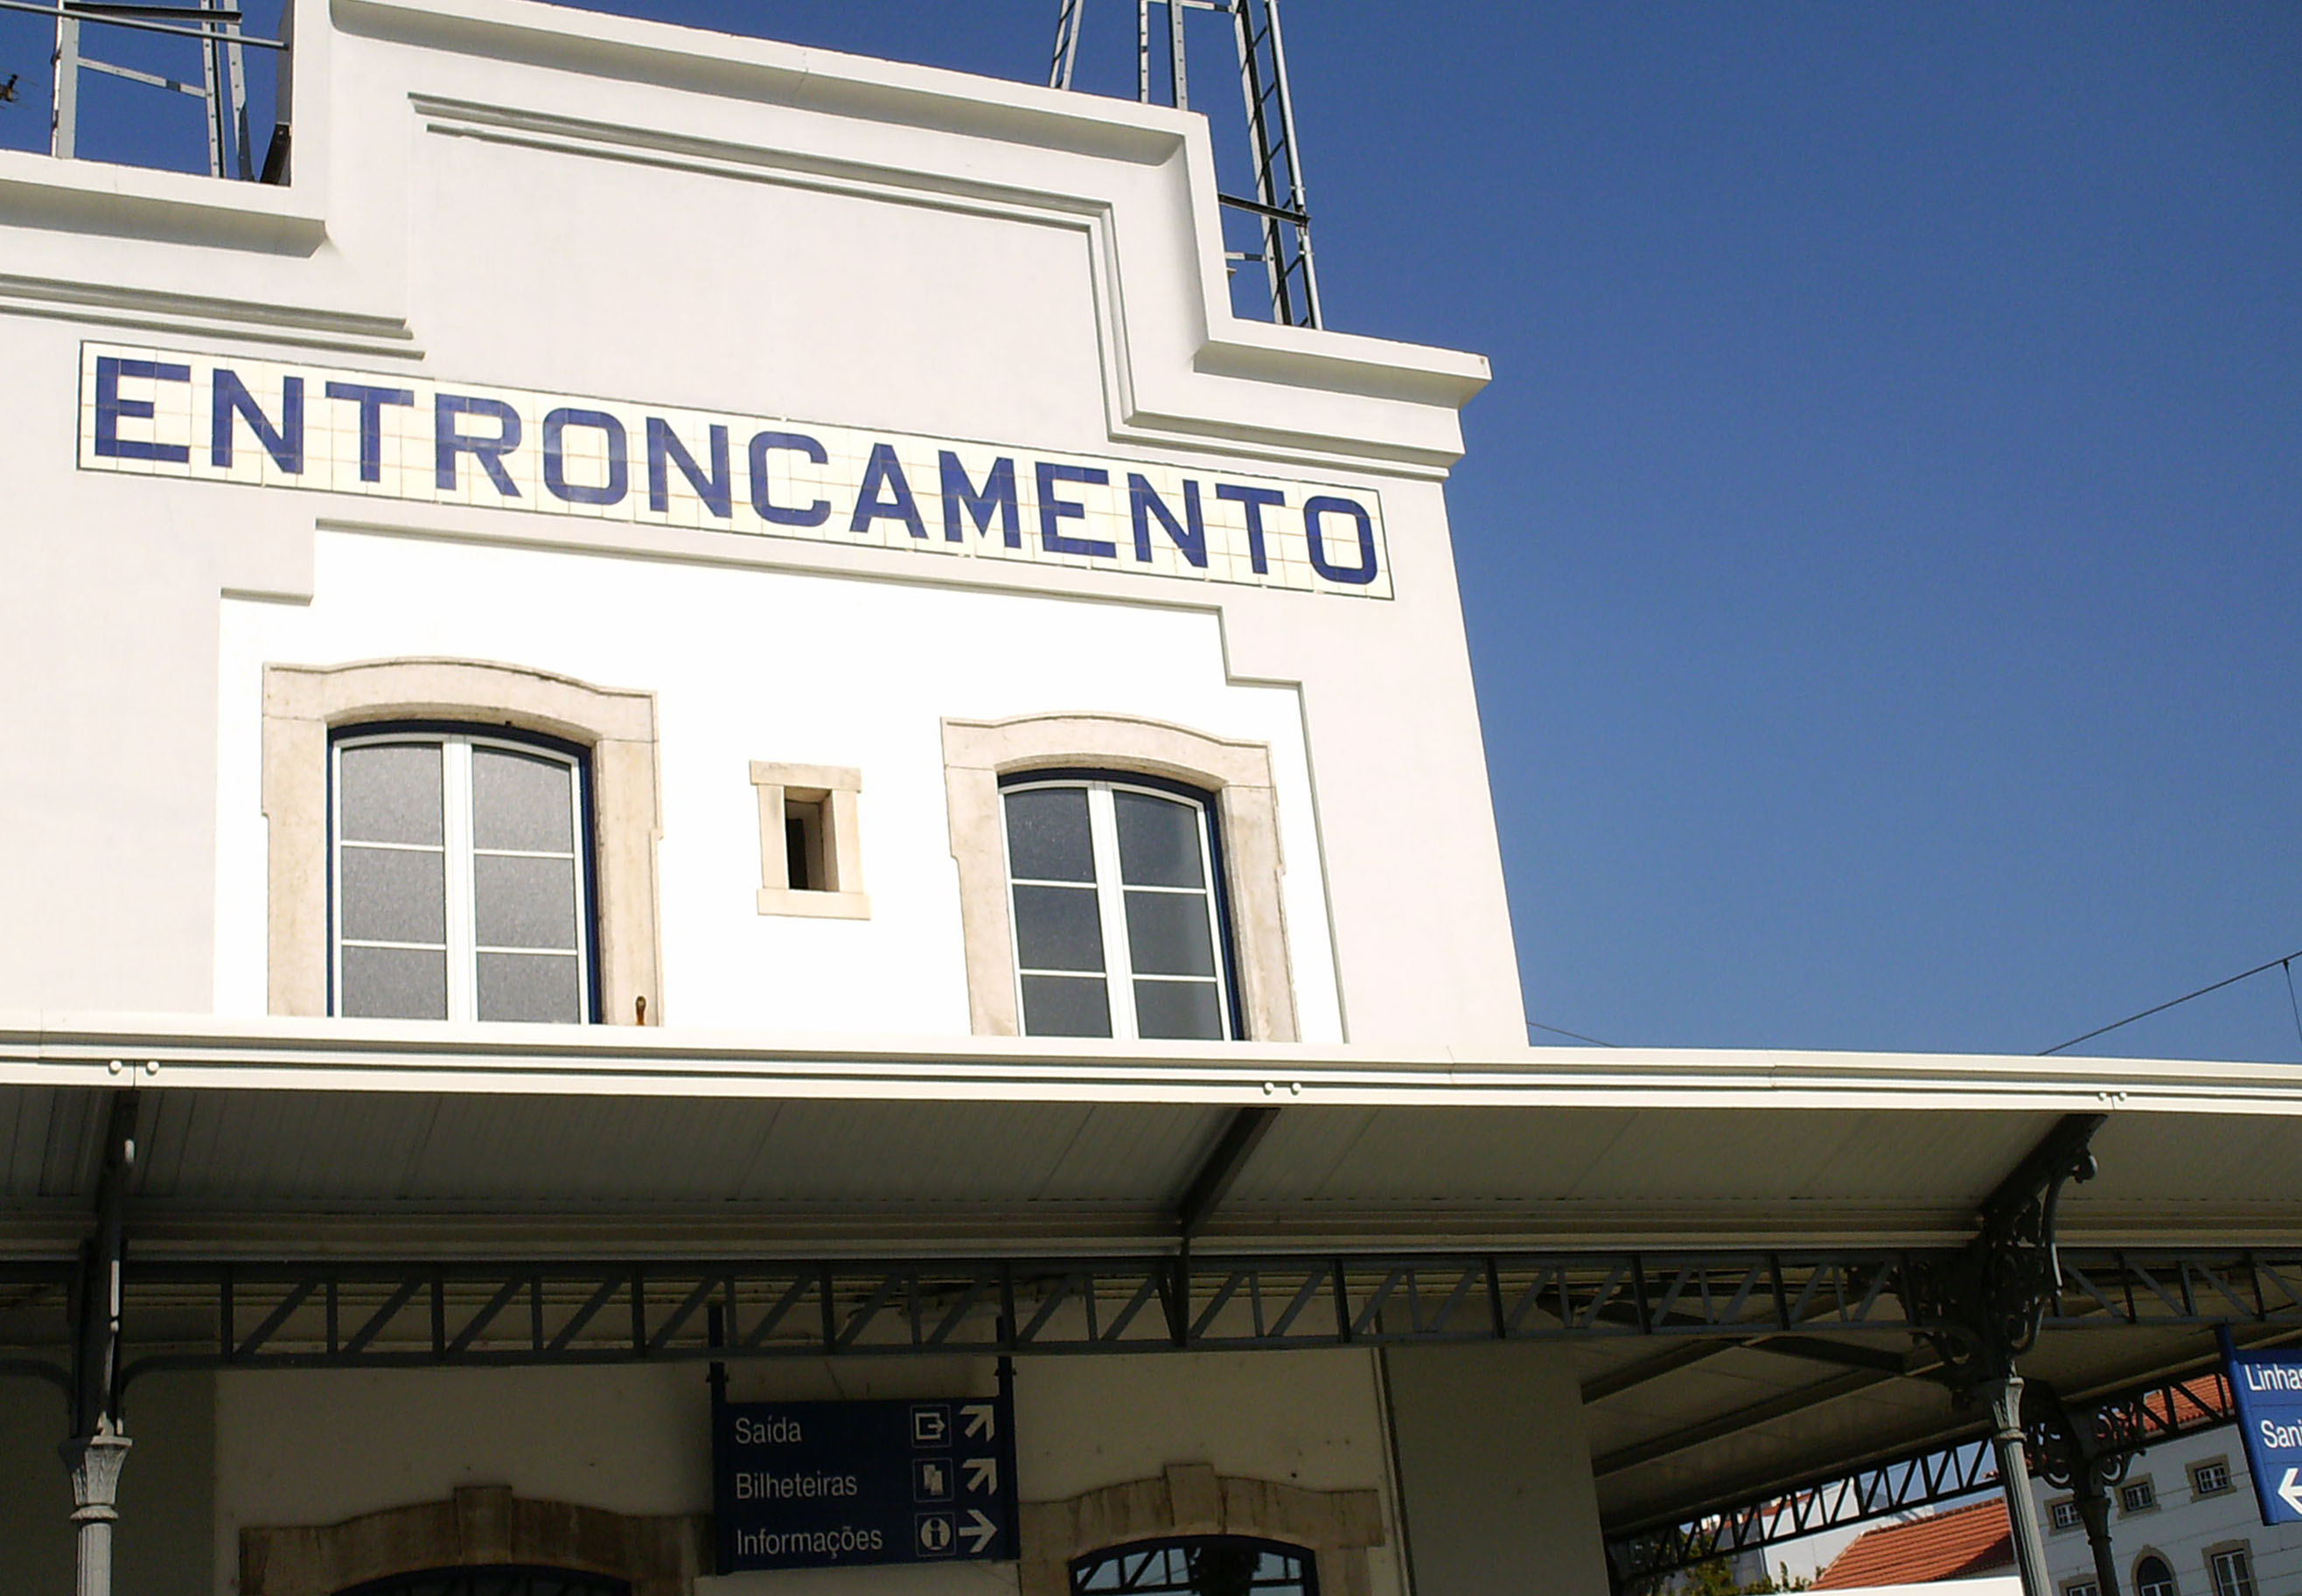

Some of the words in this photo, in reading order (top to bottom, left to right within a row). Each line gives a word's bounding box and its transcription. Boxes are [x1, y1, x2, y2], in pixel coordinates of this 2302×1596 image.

[94, 354, 1378, 585] ENTRONCAMENTO
[735, 1415, 802, 1444] Saída
[736, 1470, 858, 1500] Bilheteiras
[736, 1526, 883, 1559] Informações
